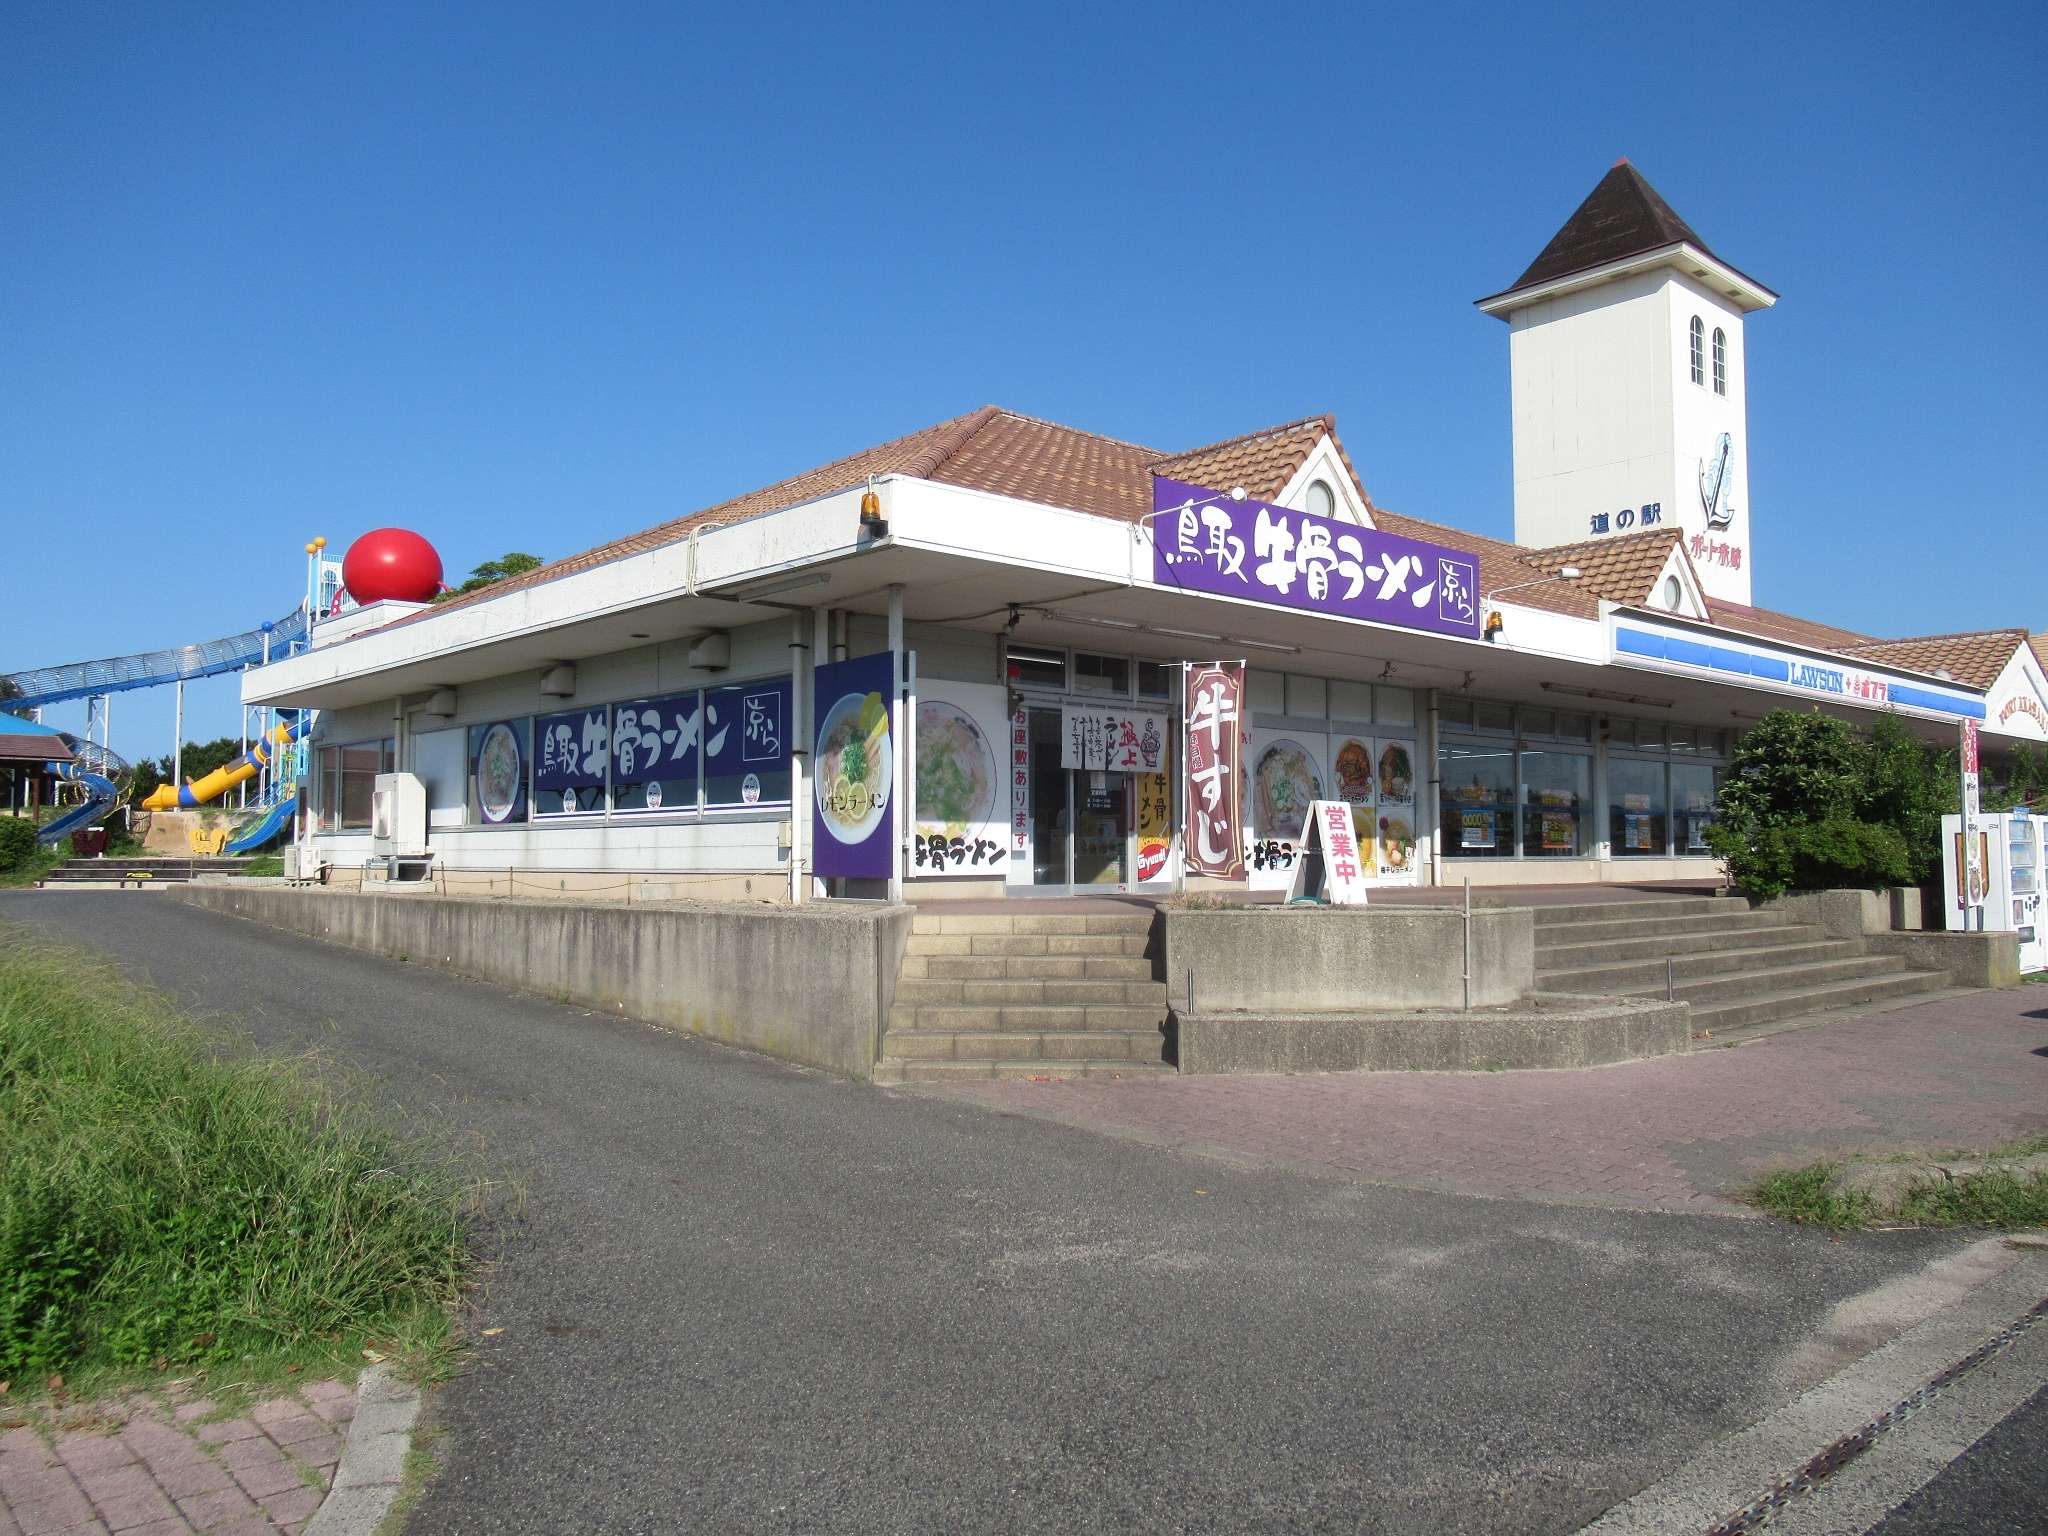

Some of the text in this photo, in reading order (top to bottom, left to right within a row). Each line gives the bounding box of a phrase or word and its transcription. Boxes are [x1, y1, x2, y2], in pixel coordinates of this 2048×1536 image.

[1590, 502, 1662, 535] 道の駅
[1791, 662, 1844, 693] LAWSON
[1014, 707, 1028, 848] お座敷あります
[1154, 773, 1167, 821] 牛骨
[1190, 681, 1237, 865] 牛すじ
[821, 793, 886, 813] レモンラーメン
[1325, 805, 1357, 886] 営業中
